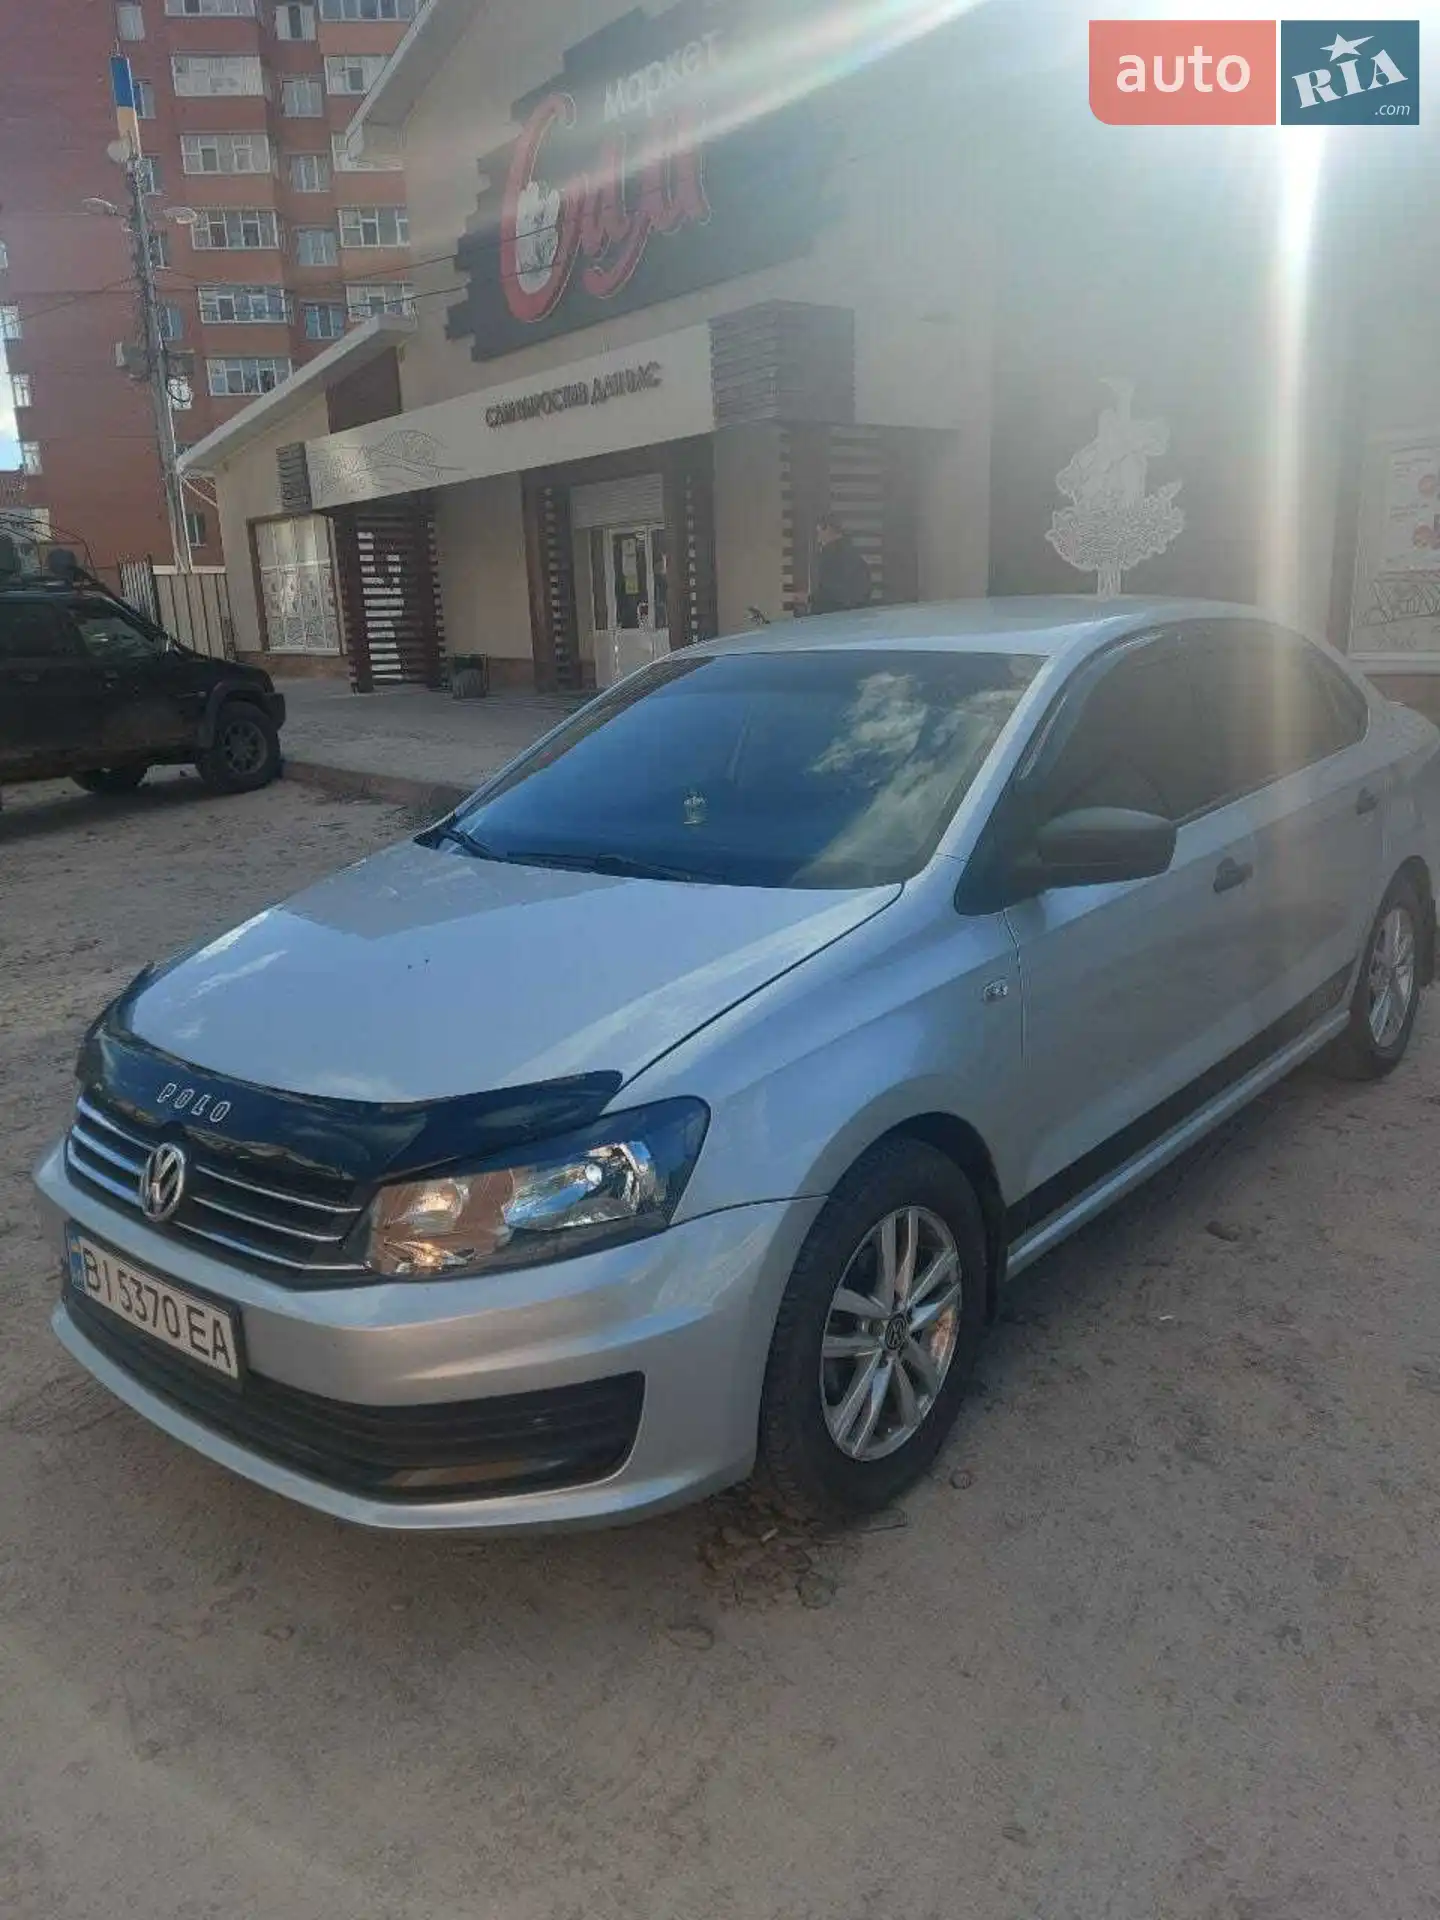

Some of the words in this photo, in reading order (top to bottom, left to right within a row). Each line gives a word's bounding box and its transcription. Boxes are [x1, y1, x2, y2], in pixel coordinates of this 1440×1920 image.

[157, 1082, 231, 1123] POLO
[117, 1269, 181, 1340] 5370
[187, 1304, 232, 1370] EA
